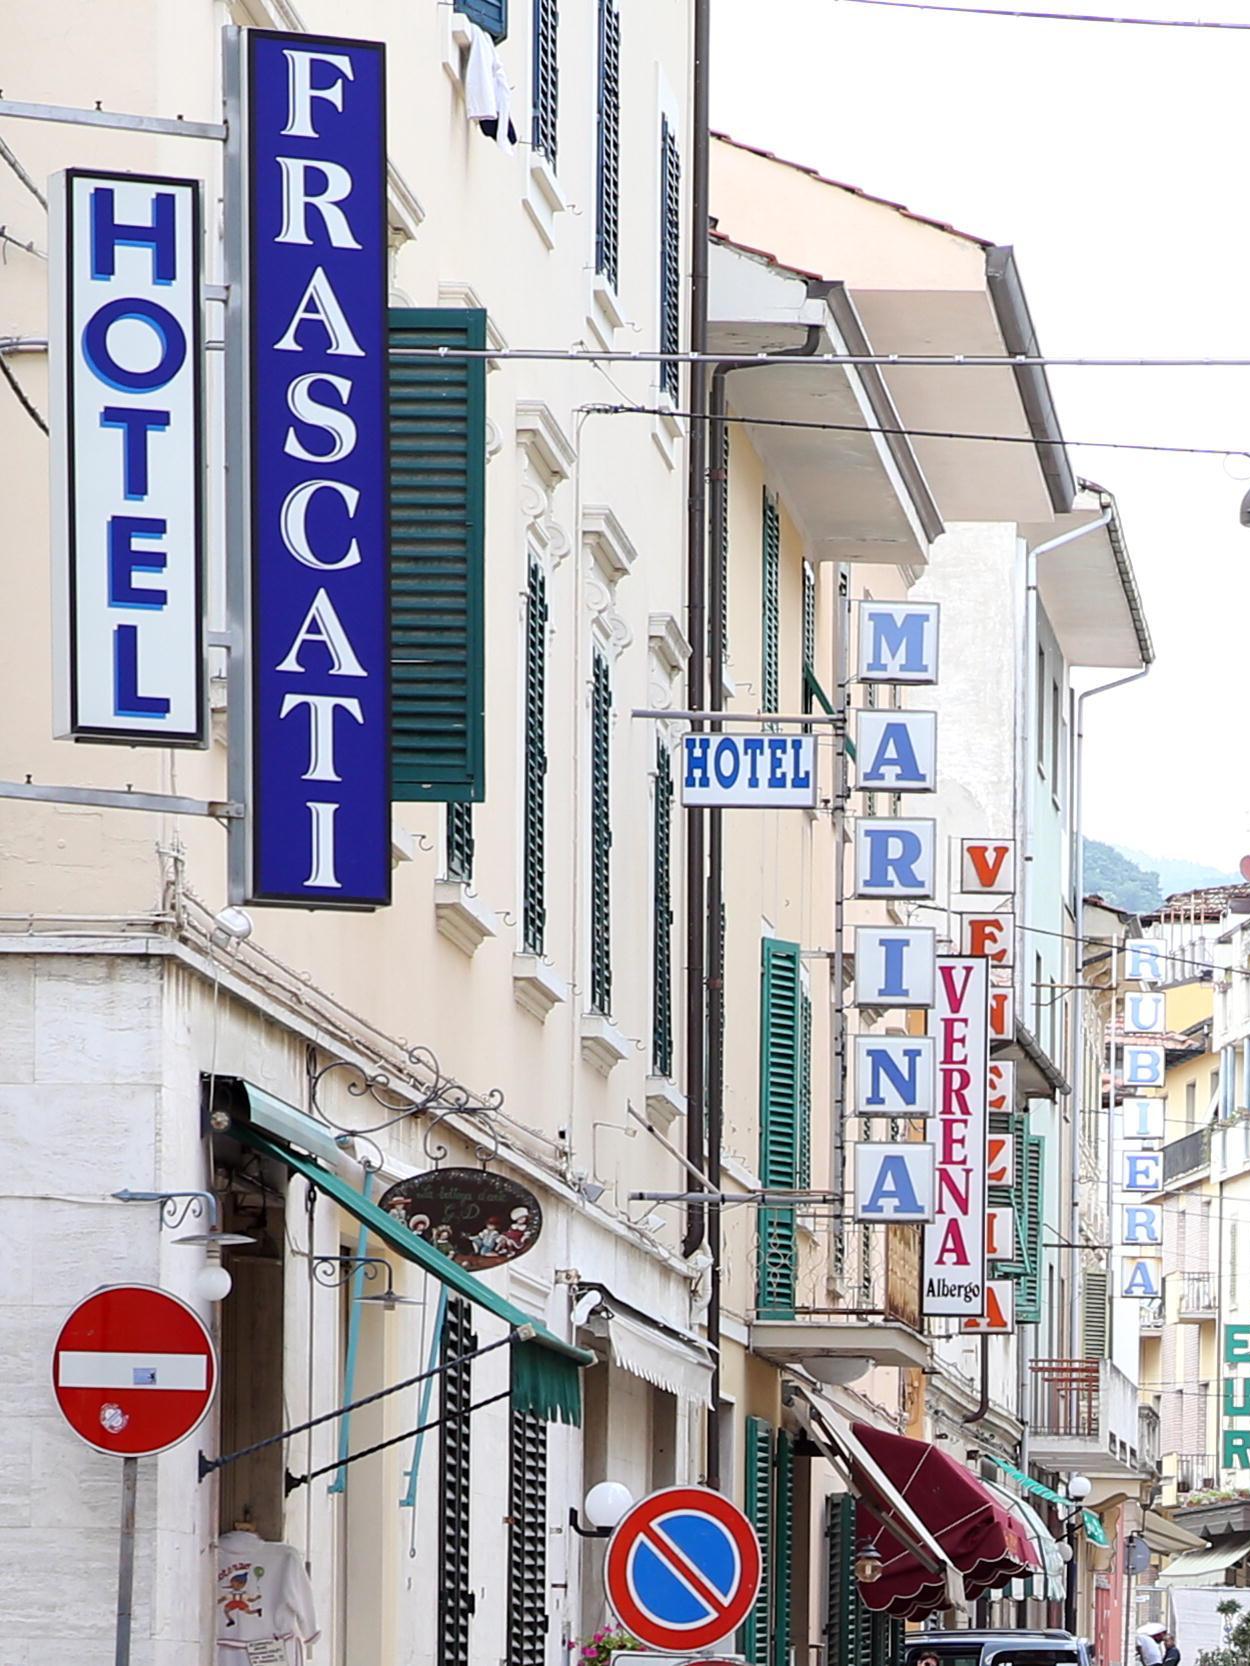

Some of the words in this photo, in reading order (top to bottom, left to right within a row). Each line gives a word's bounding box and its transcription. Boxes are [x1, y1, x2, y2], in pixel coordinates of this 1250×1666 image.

[81, 187, 187, 719] HOTEL
[273, 49, 368, 889] FRASCATI
[684, 737, 811, 789] HOTEL
[862, 612, 930, 1214] MARINA
[926, 1278, 980, 1303] Albergo
[934, 965, 974, 1266] VERENA
[1124, 943, 1161, 1296] RUBIERA
